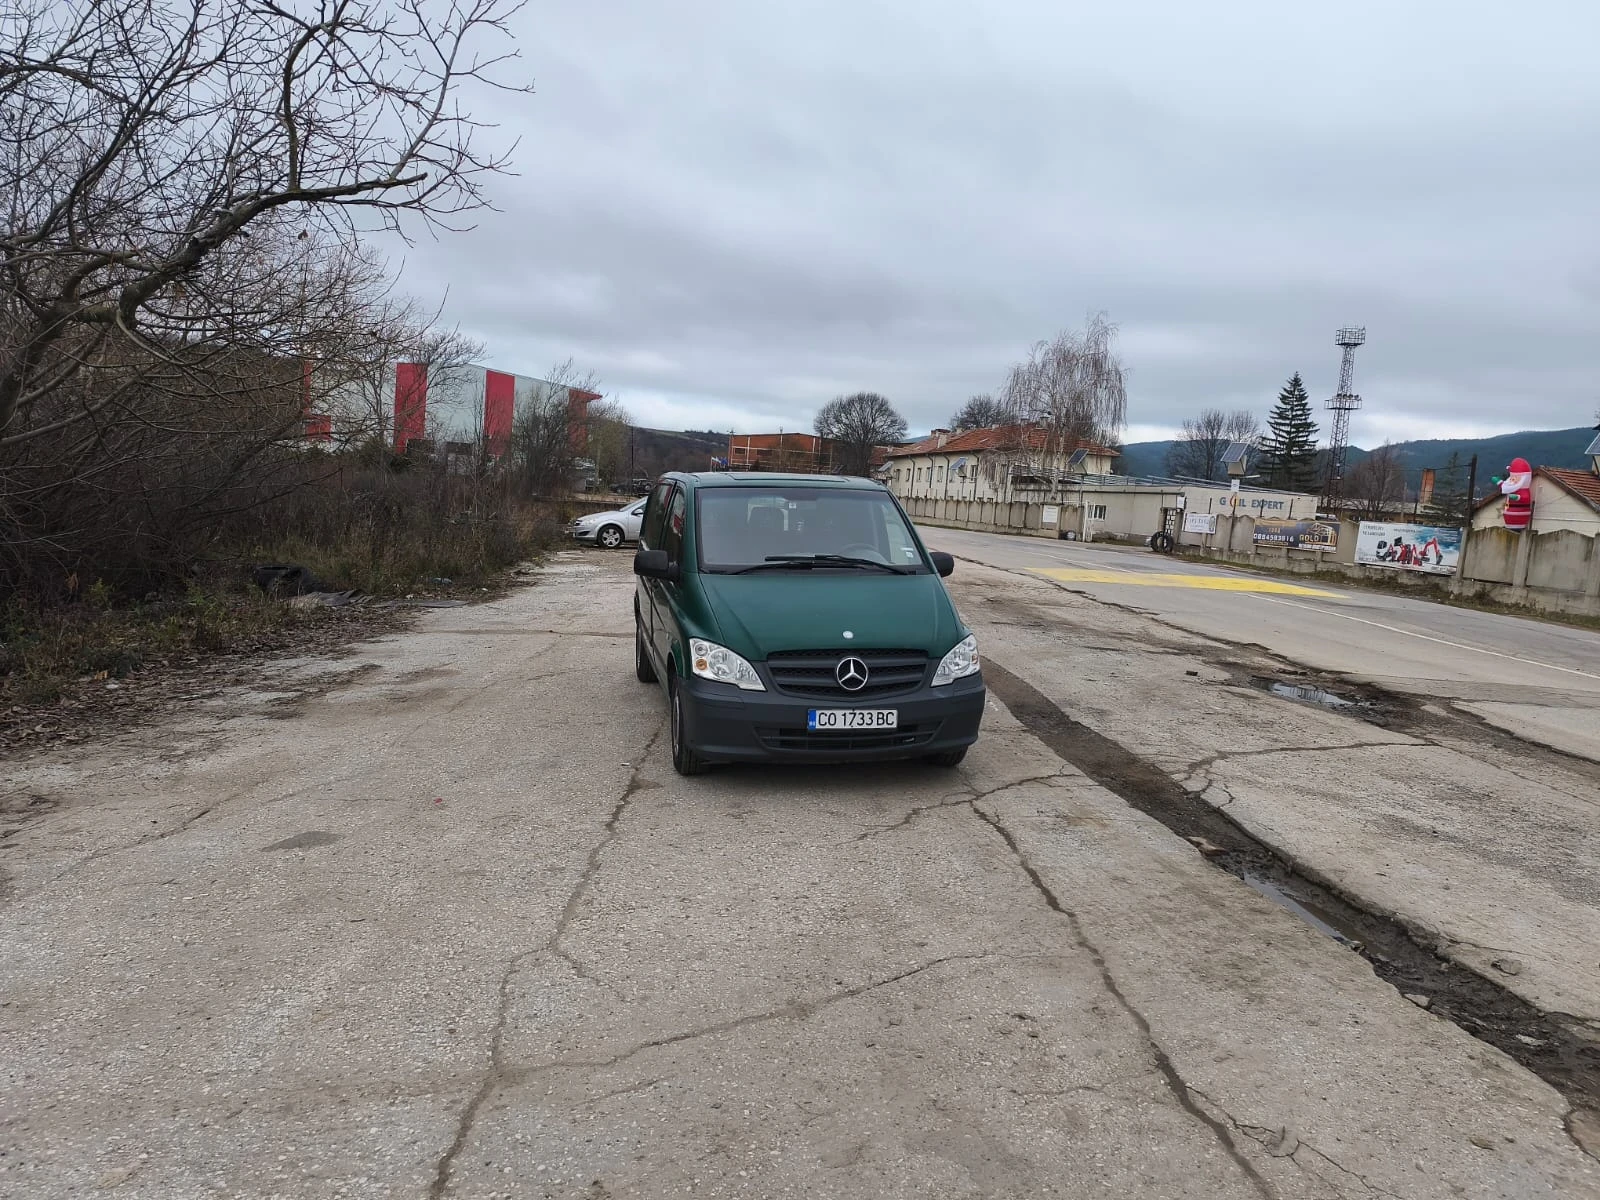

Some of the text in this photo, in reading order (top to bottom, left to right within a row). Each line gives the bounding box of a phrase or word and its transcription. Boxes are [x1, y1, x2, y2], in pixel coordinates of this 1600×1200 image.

[1251, 499, 1285, 511] EXPERT
[818, 711, 895, 727] CO 1733 BC
